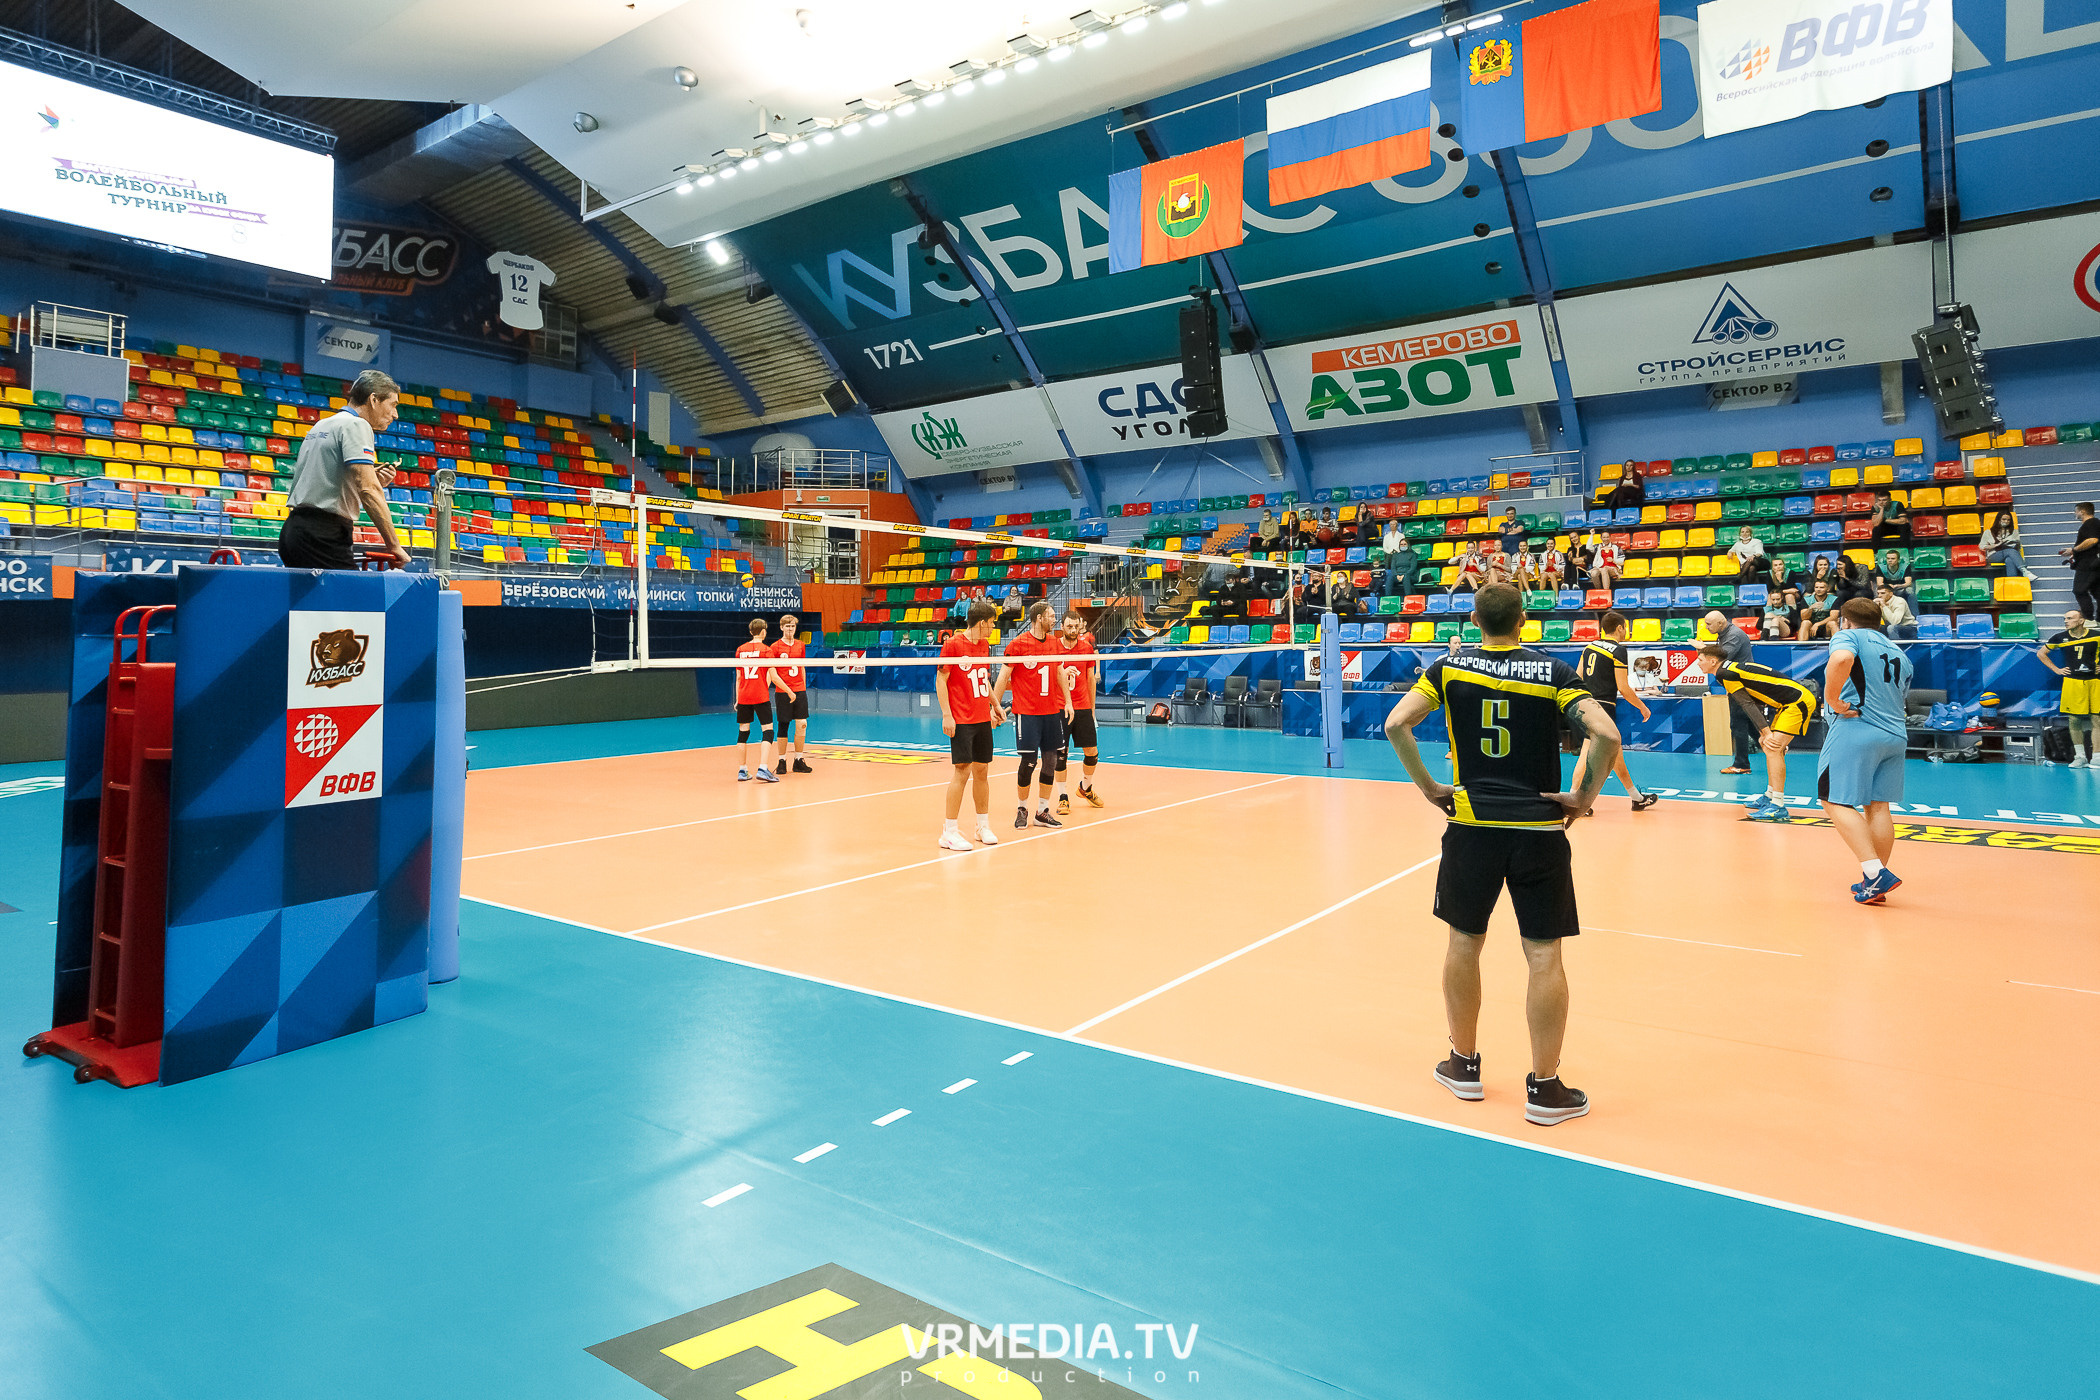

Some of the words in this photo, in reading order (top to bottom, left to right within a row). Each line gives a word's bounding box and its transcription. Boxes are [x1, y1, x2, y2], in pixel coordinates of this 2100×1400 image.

[1776, 0, 1931, 73] ВФВ
[1716, 76, 1798, 102] Всероссийская
[1800, 61, 1866, 83] федерация
[54, 168, 228, 205] ВОЛЕЙБОЛЬНЫЙ
[107, 193, 188, 214] ТУРНИР
[332, 228, 449, 278] БАСС
[510, 273, 529, 293] 12
[324, 336, 363, 350] СЕКТОР
[366, 344, 373, 353] А
[864, 338, 924, 370] 1721
[1341, 324, 1512, 368] КЕМЕРОВО
[1637, 338, 1846, 375] СТРОЙСЕРВИС
[1640, 372, 1702, 384] ГРУППА
[1712, 353, 1847, 376] ПРЕДПРИЯТИЙ
[1304, 345, 1522, 421] АЗОТ
[1712, 384, 1769, 400] СЕКТОР
[1774, 382, 1793, 393] В2
[950, 460, 992, 470] КОМПАНИЯ
[980, 475, 1006, 485] СЕКТОР
[504, 582, 606, 600] БЕРЁЗОВСКИЙ
[696, 591, 734, 602] ТОПКИ
[740, 595, 801, 609] КУЗНЕЦКИЙ
[746, 587, 794, 598] ЛЕНИНСК
[1586, 652, 1597, 677] 9
[2074, 645, 2084, 660] 7
[309, 662, 364, 683] КУЗБАСС
[1038, 665, 1050, 697] 1
[1447, 656, 1510, 677] КЕДРОВСКИЙ
[1510, 661, 1552, 682] РАЗРЕЗ
[1681, 675, 1706, 684] ВФВ
[967, 667, 990, 698] 13
[1480, 698, 1511, 759] 5
[319, 771, 377, 798] ВФВ
